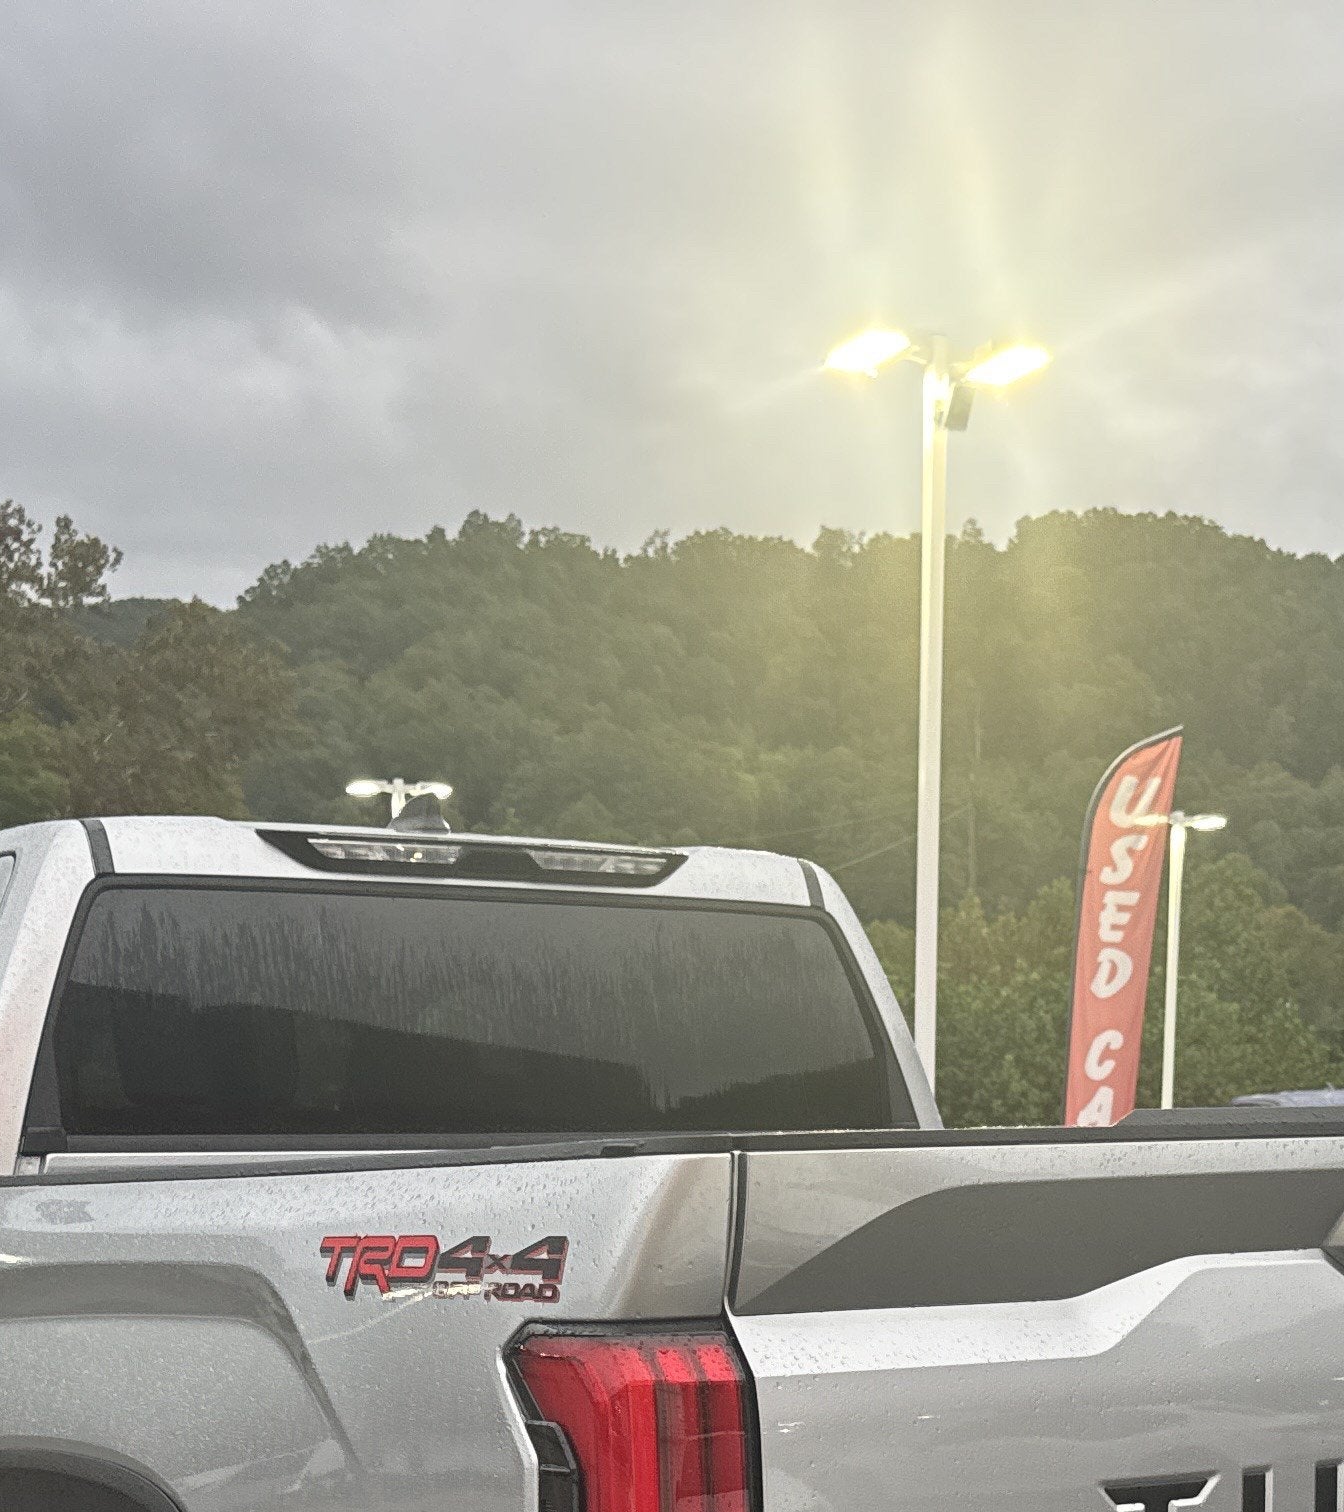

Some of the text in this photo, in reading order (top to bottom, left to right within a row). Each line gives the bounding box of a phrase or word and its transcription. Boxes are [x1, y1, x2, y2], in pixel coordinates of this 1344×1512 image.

[1090, 775, 1162, 998] USED
[320, 1234, 440, 1301] TRD
[484, 1282, 561, 1303] ROAD
